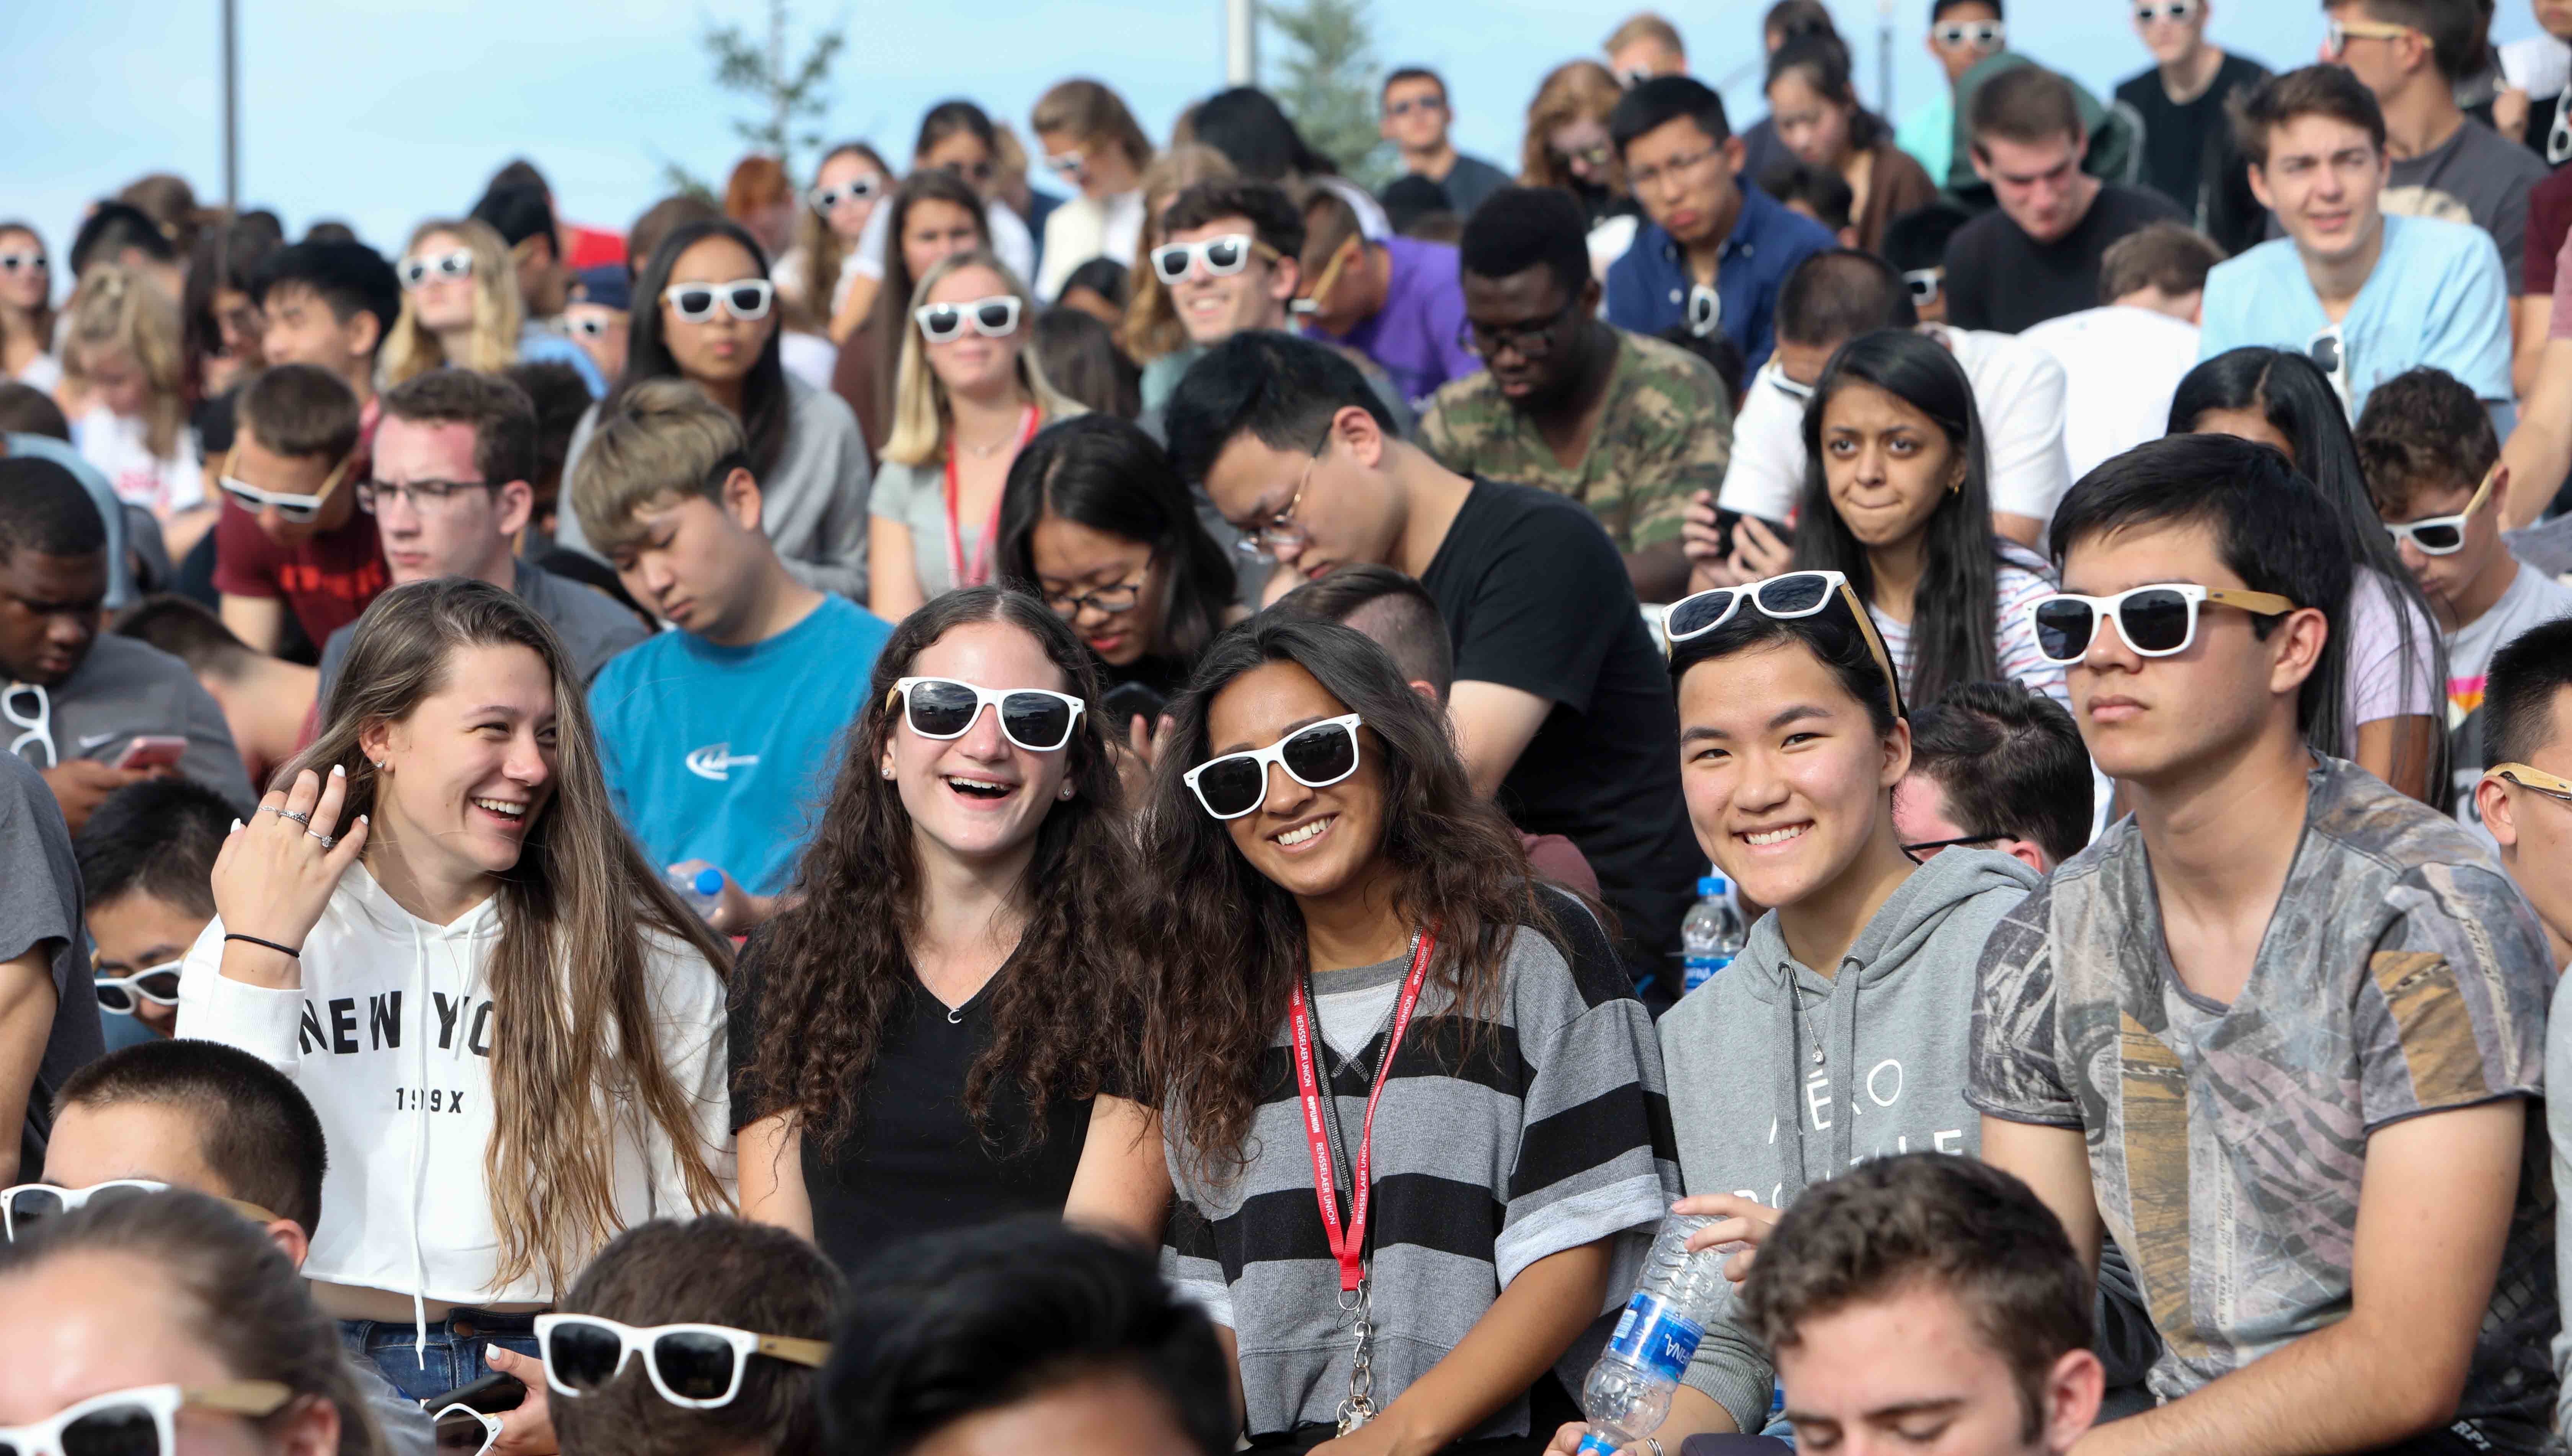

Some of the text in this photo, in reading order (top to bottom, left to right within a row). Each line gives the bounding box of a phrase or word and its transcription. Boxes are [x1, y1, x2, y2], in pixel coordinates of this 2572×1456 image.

[299, 991, 402, 1055] NEW
[1296, 1015, 1312, 1087] RENSSELAER UNION
[1383, 996, 1413, 1076] RENSSELAER UNION
[1307, 1095, 1320, 1133] @RPIUNION
[1315, 1142, 1337, 1225] RENSSELAER UNION
[1357, 1170, 1367, 1224] RENSSELAER
